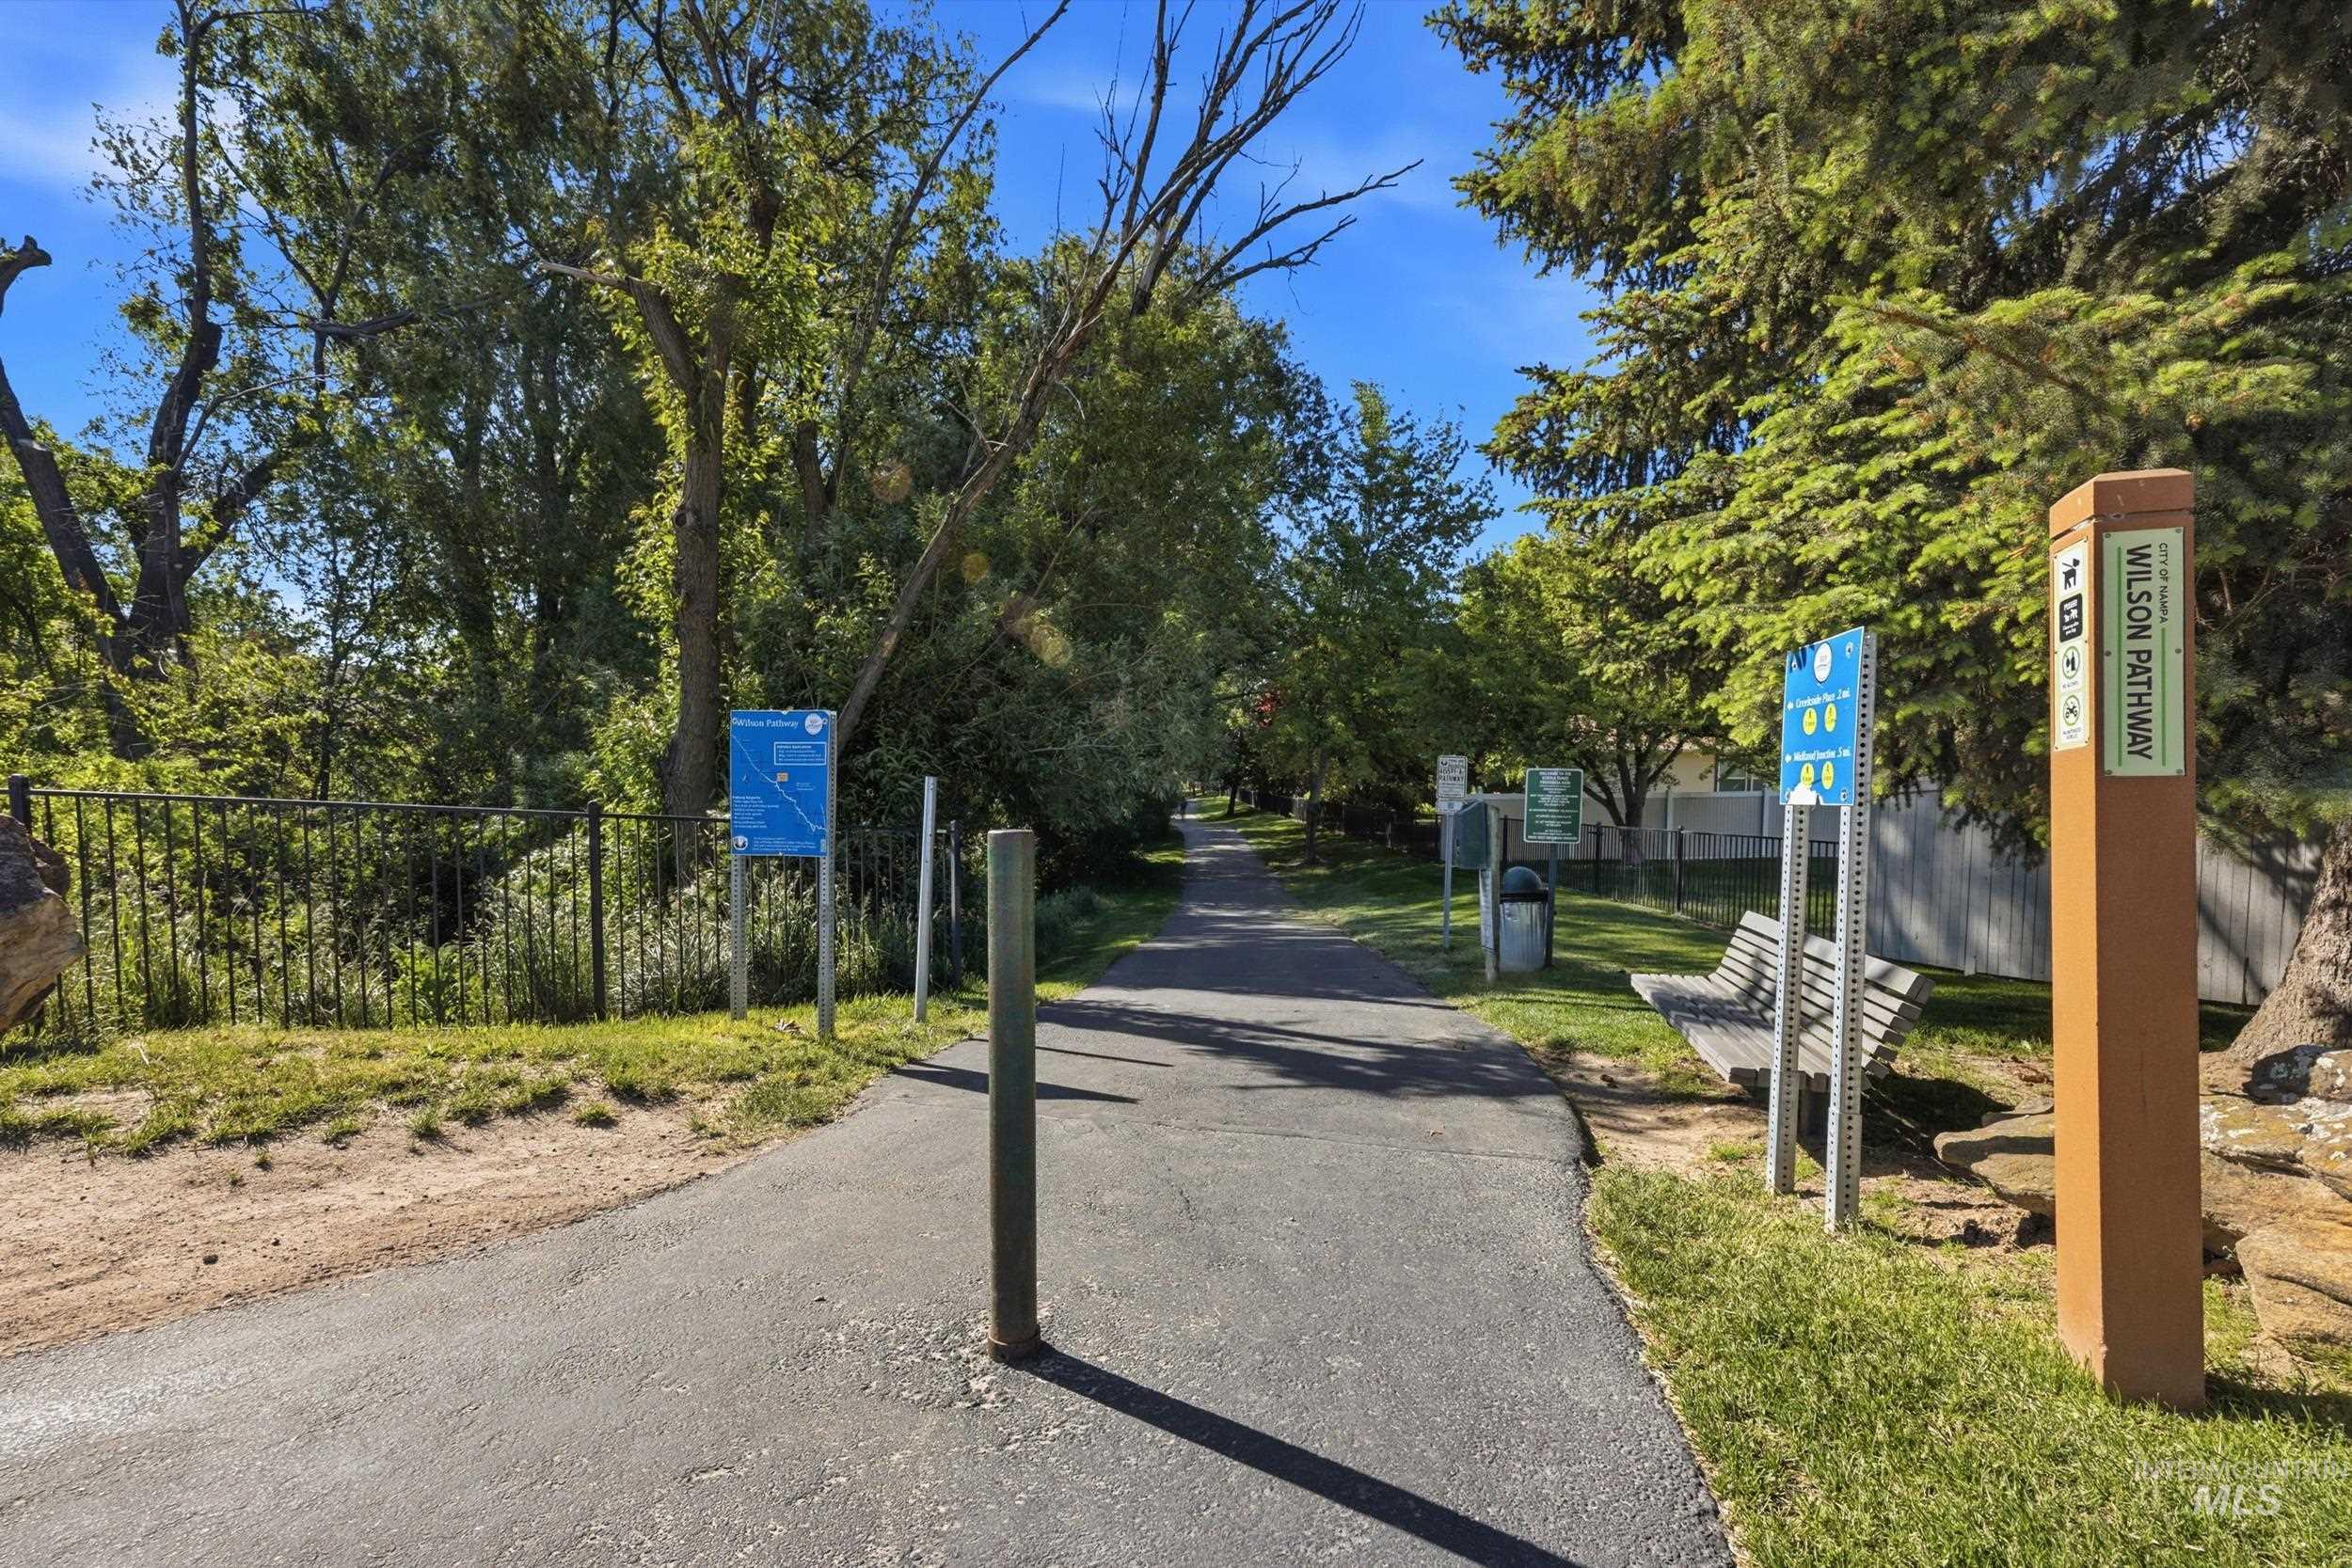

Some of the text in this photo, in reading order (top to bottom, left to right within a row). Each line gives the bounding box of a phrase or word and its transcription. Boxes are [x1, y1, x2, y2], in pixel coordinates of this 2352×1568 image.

[2159, 542, 2169, 625] CITY OF NAMPA
[2125, 544, 2153, 762] WILSON PATHWAY
[1795, 694, 1821, 708] Creekside
[1822, 692, 1836, 704] Place
[737, 718, 764, 727] Wilson
[766, 719, 799, 729] Pathway
[1793, 751, 1816, 761] Midland
